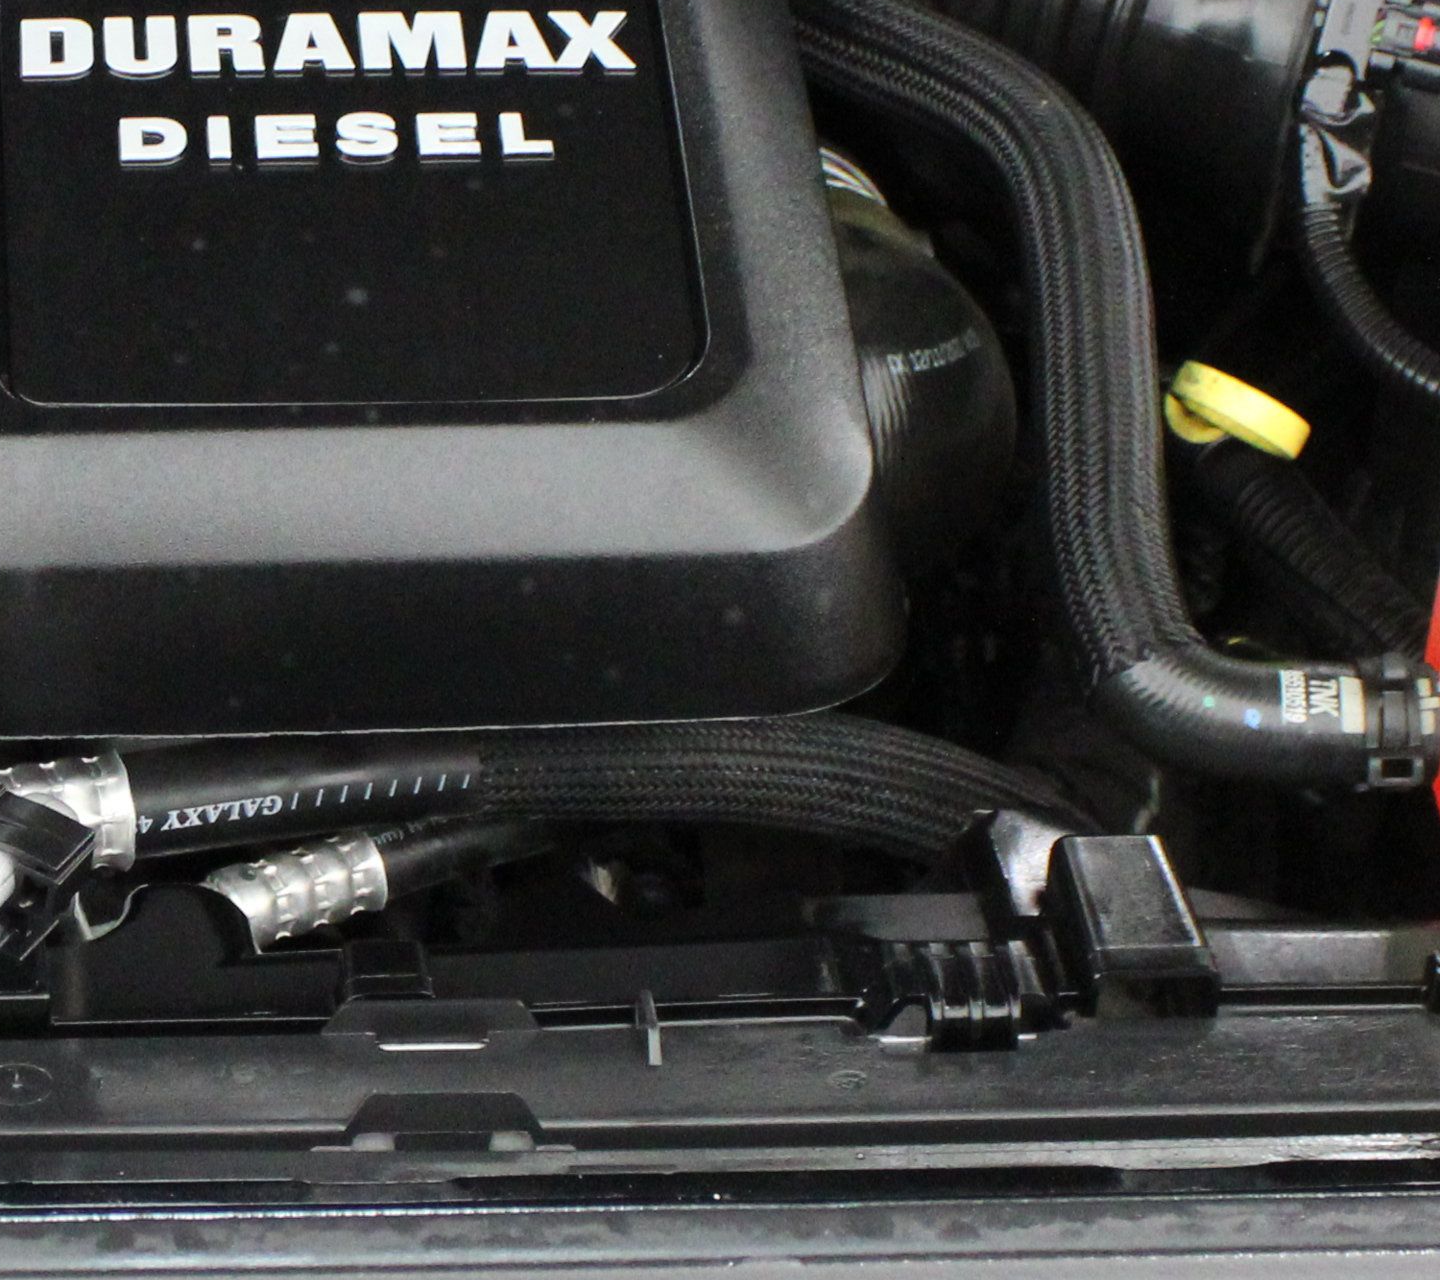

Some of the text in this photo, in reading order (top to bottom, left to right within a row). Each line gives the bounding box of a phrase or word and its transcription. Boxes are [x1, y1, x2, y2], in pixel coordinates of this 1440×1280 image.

[21, 10, 637, 80] DURAMAX
[120, 111, 555, 165] DIESEL
[1309, 678, 1339, 718] TNK
[160, 794, 284, 832] GALAXY
